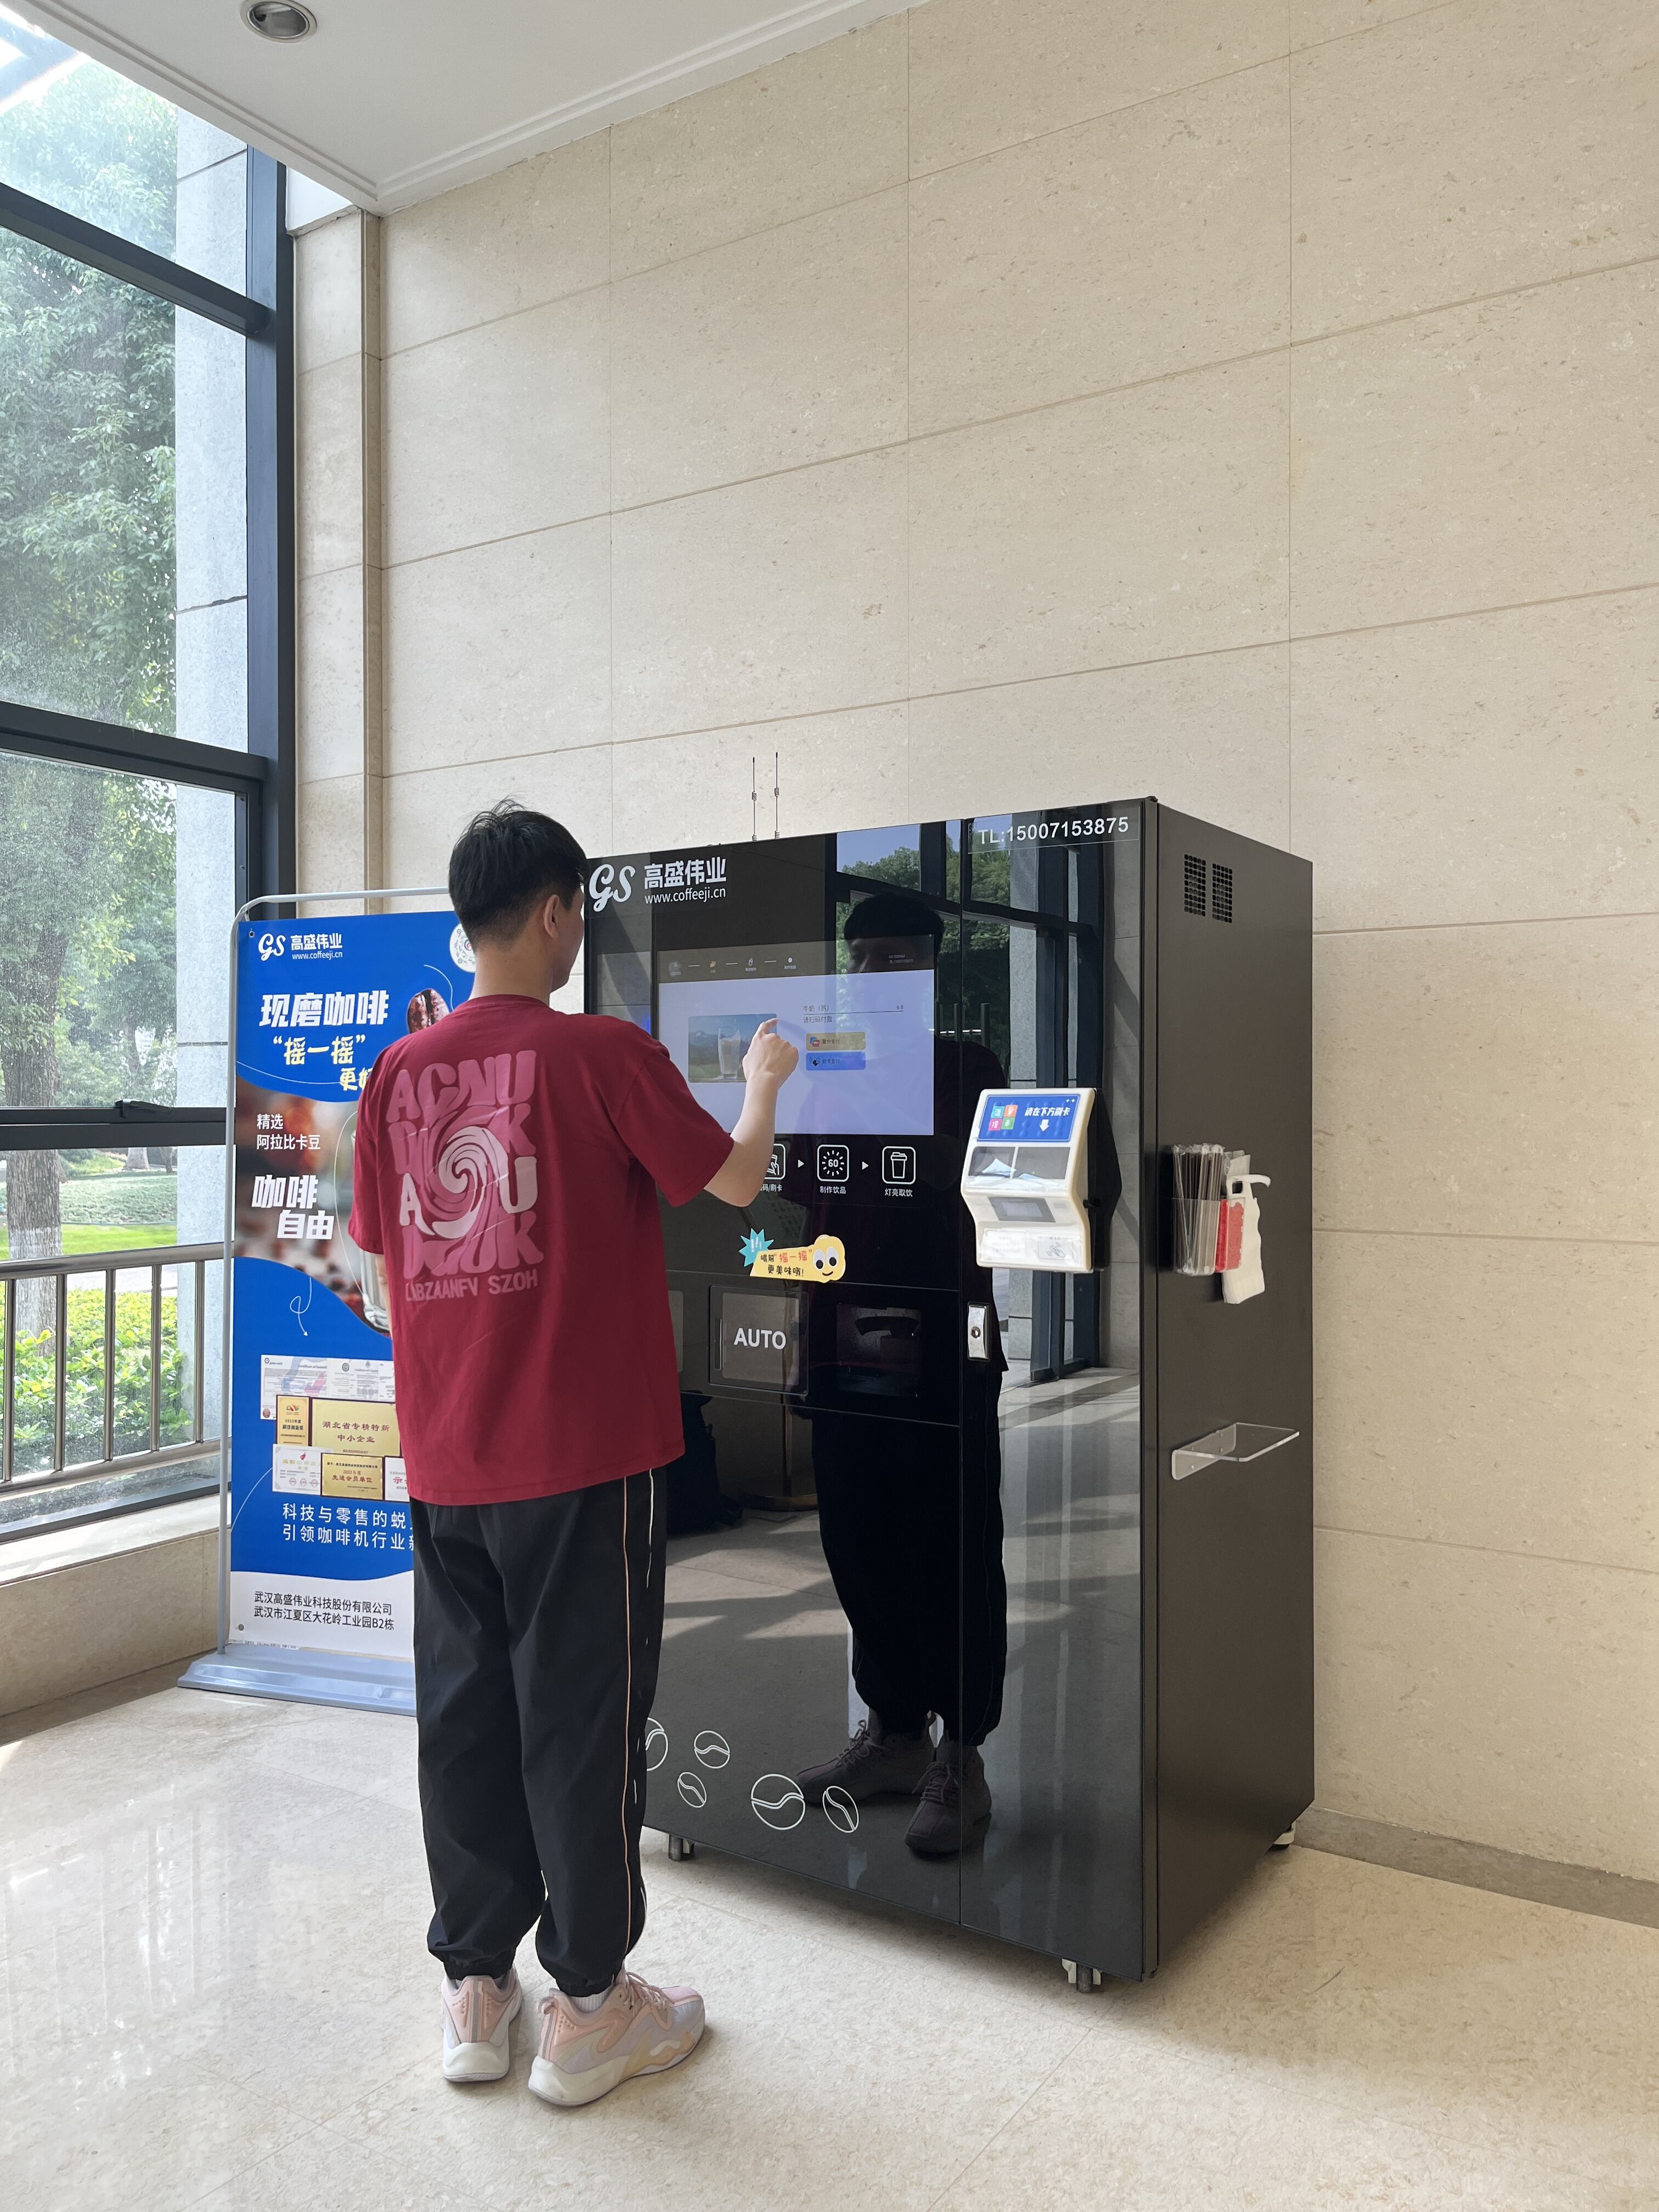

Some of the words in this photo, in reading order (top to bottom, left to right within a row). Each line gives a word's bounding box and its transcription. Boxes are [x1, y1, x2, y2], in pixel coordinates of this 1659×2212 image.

[978, 816, 1128, 844] TL:15007153875
[644, 857, 726, 889] 高盛伟业
[589, 864, 635, 912] GS
[645, 887, 726, 904] www.coffeeji.cn
[258, 933, 286, 961] GS
[291, 933, 343, 950] 高盛伟业
[292, 951, 343, 960] www.coffeeji.cn
[259, 990, 389, 1028] 现磨咖啡
[257, 1114, 283, 1130] 精选
[1024, 1107, 1070, 1116] 请在下方刷卡
[257, 1133, 320, 1150] 阿拉比卡豆
[828, 1159, 838, 1167] 60
[251, 1175, 318, 1209] 咖啡
[760, 1183, 782, 1192] 码/刷卡
[820, 1186, 846, 1194] 制作饮品
[884, 1188, 913, 1197] 灯亮取饮
[277, 1210, 335, 1239] 自由
[488, 1268, 538, 1295] SZOH
[734, 1328, 786, 1349] AUTO
[337, 1434, 375, 1443] 中小企业
[283, 1503, 413, 1530] 科技与零售的蜕
[254, 1591, 392, 1616] 武汉高盛伟业科技股份有限公司
[254, 1606, 394, 1630] 武汉市江夏区大花岭工业园B2栋
